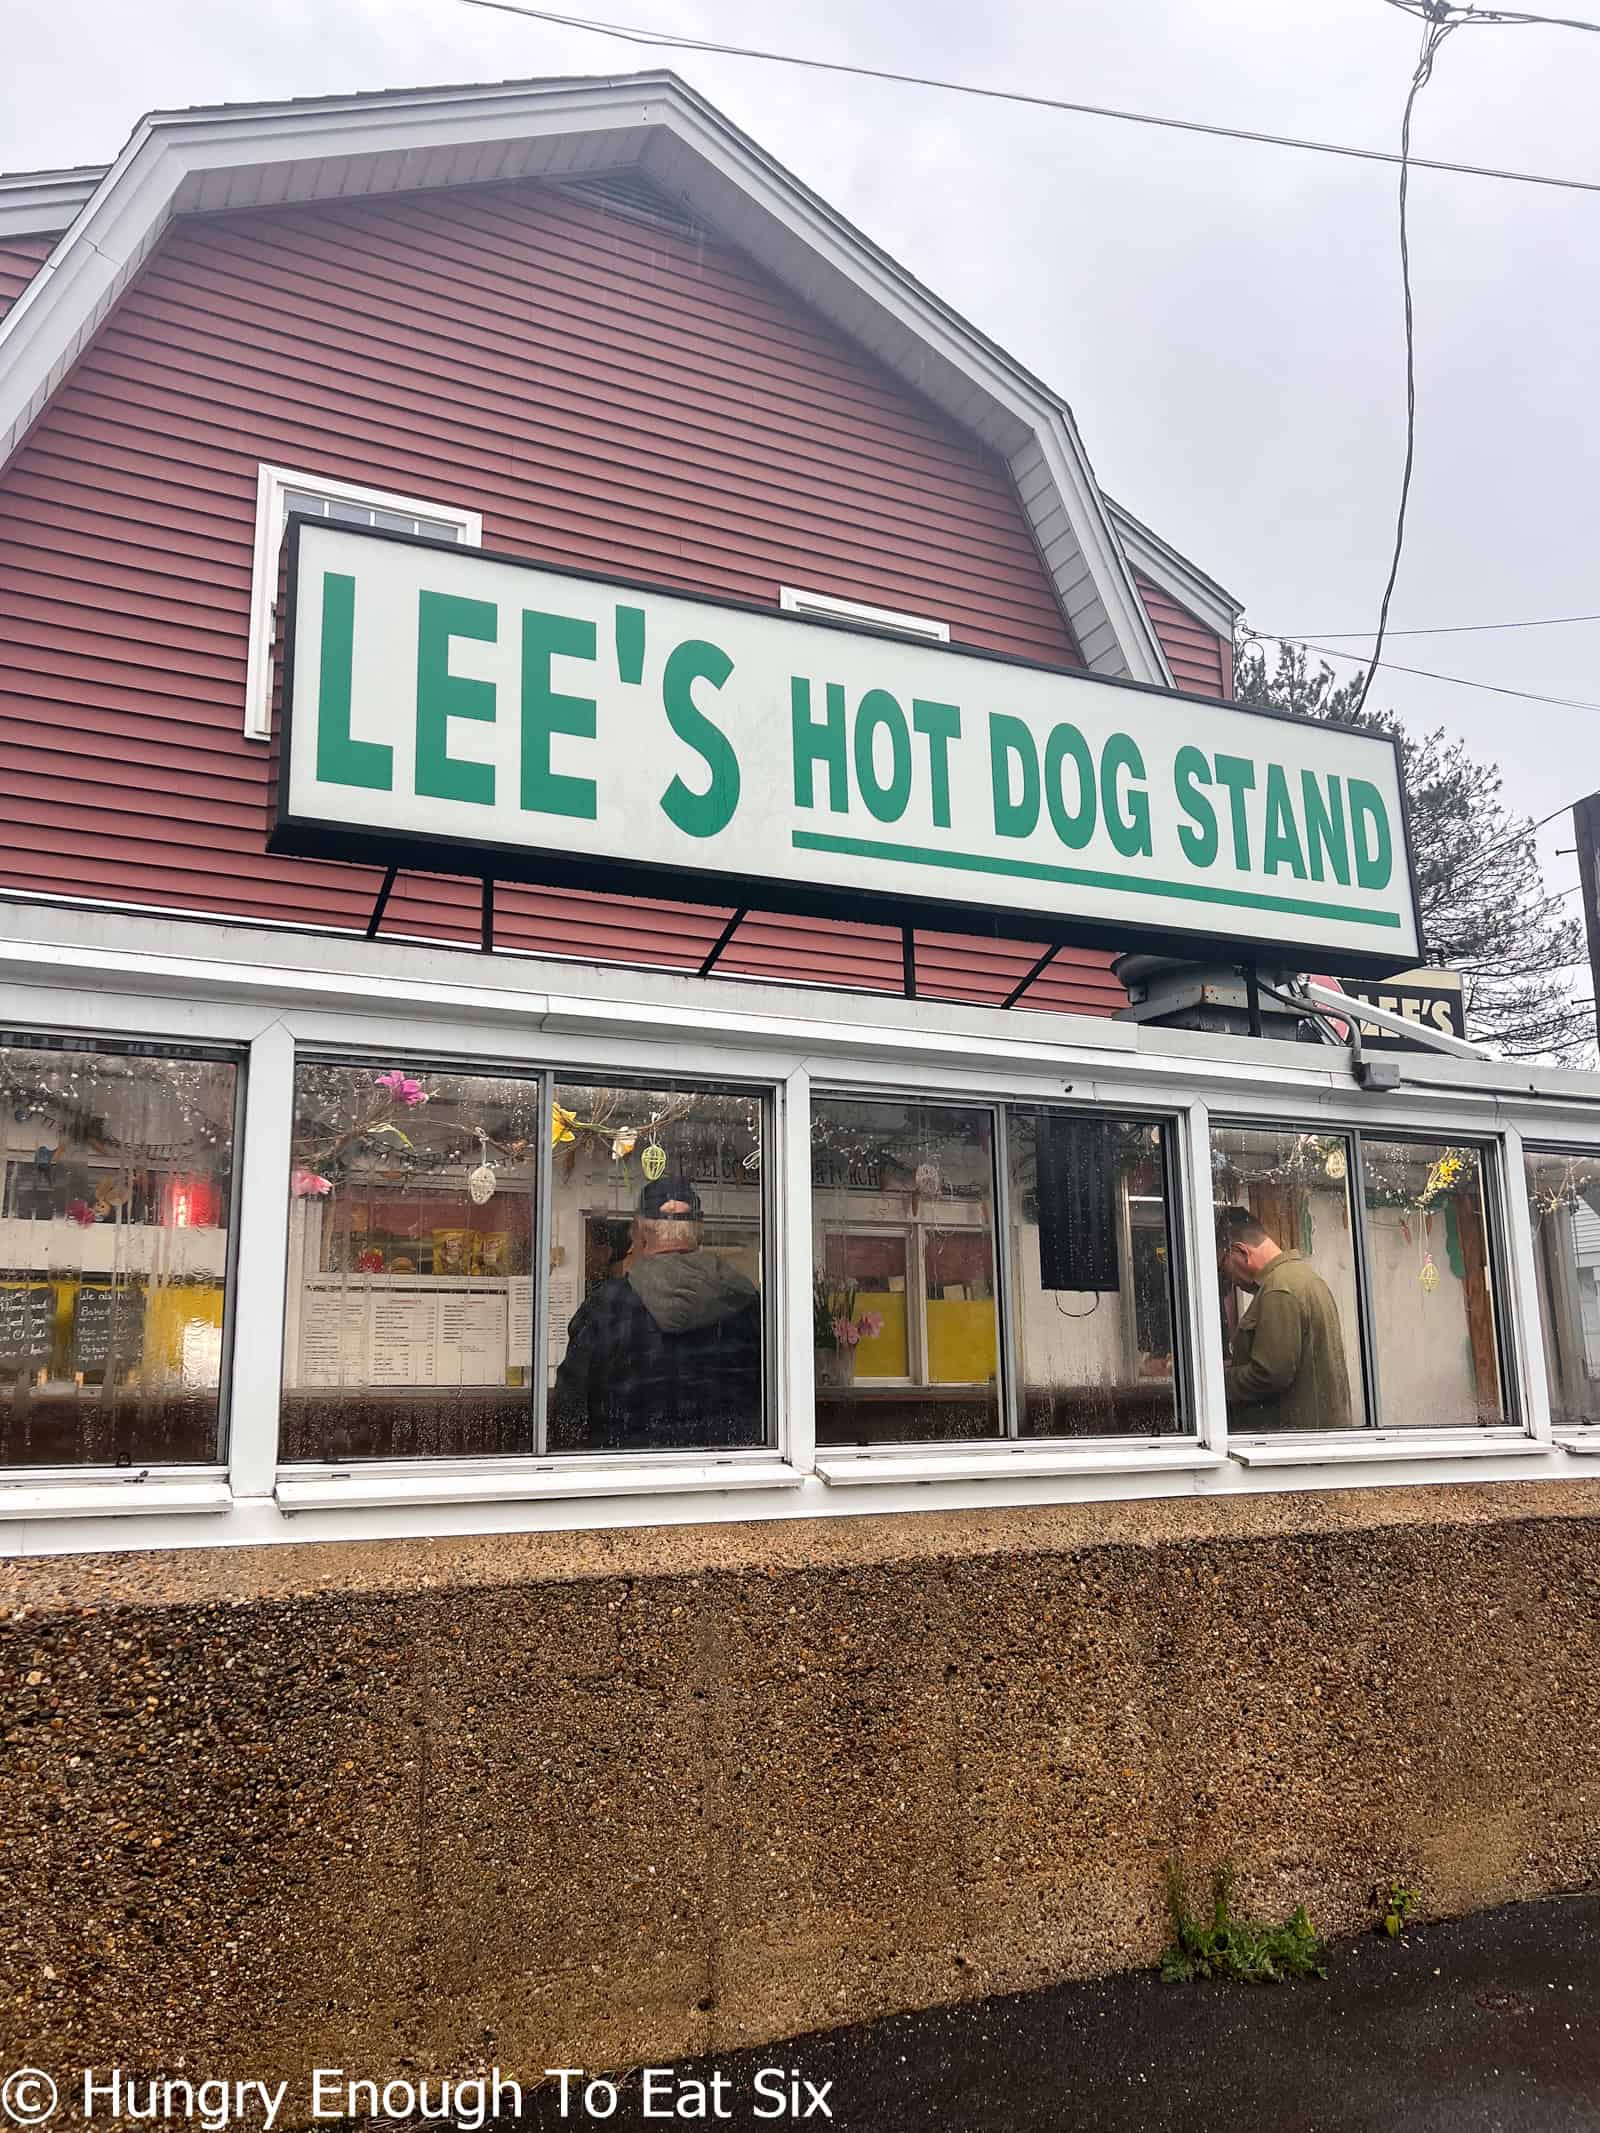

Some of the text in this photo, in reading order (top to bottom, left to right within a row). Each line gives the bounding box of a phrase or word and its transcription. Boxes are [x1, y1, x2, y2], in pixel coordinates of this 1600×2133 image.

[316, 571, 1393, 890] LEE'S HOT DOG STAND
